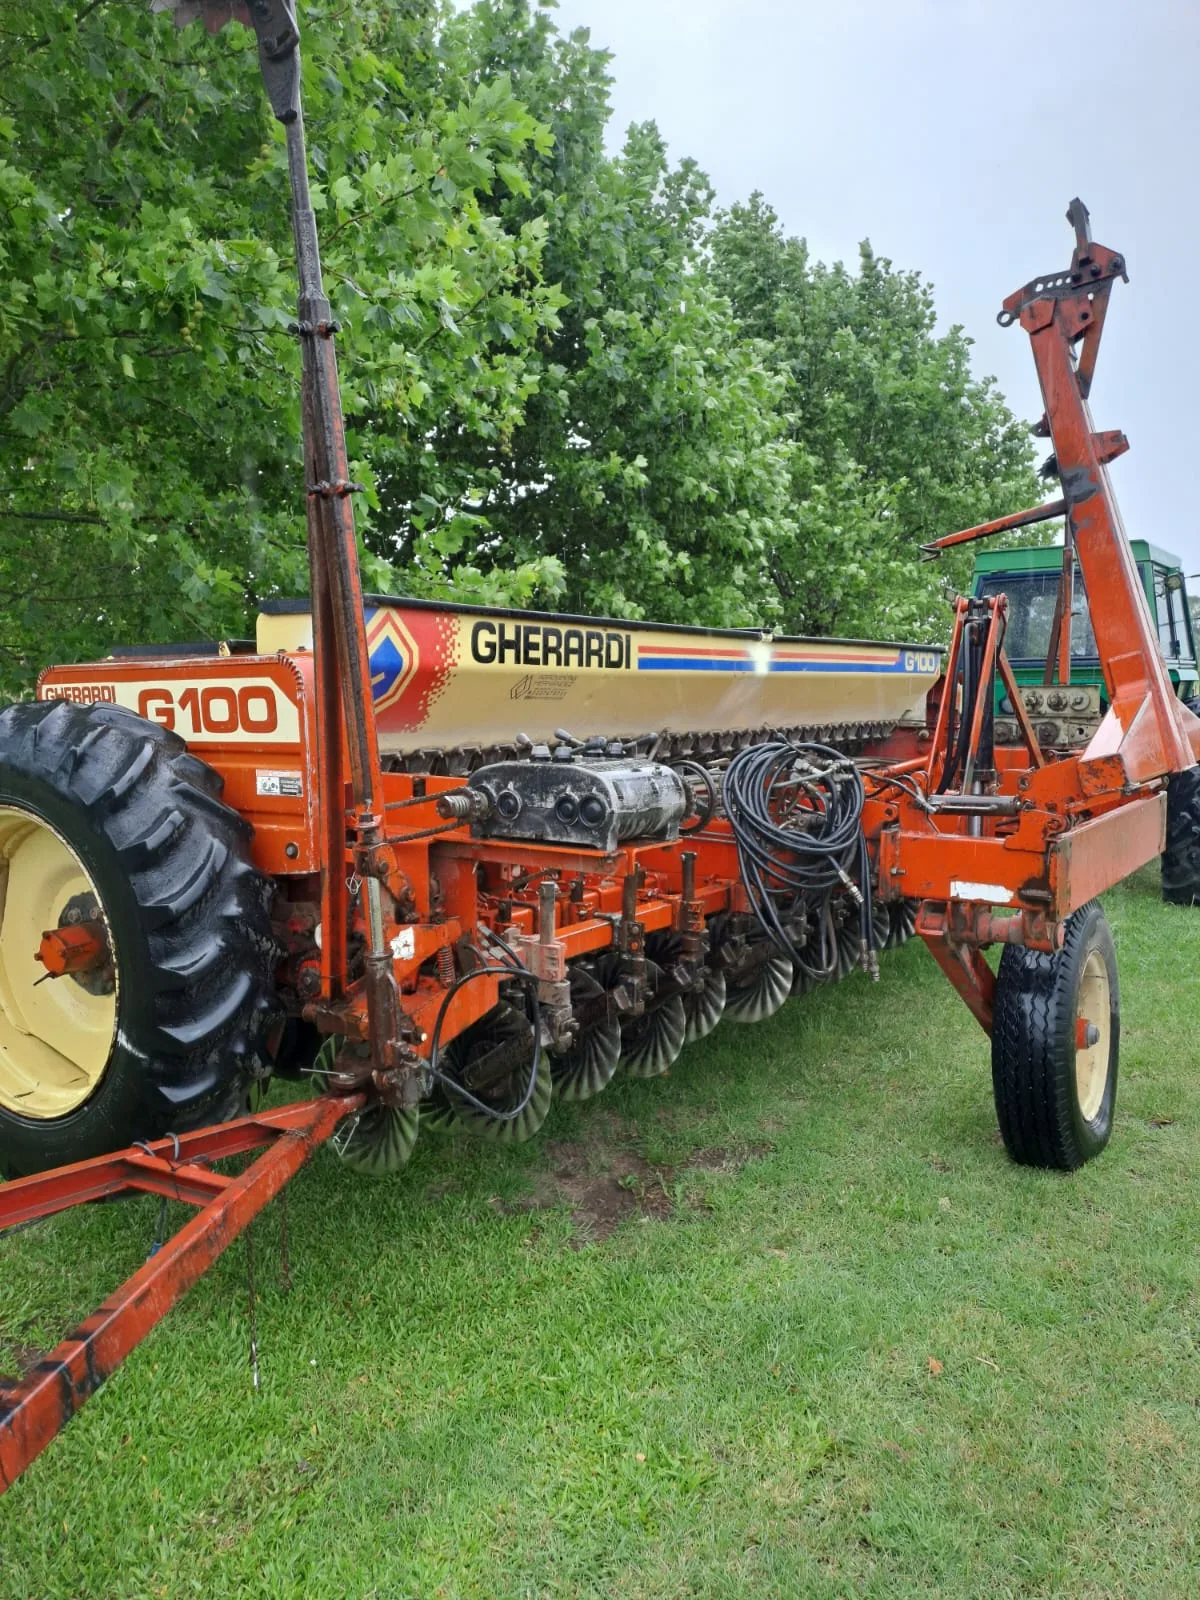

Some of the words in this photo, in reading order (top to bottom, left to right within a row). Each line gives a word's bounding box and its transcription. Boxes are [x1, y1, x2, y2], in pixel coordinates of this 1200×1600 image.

[471, 621, 631, 669] GHERARDI
[905, 651, 935, 672] G100
[138, 686, 278, 734] G100
